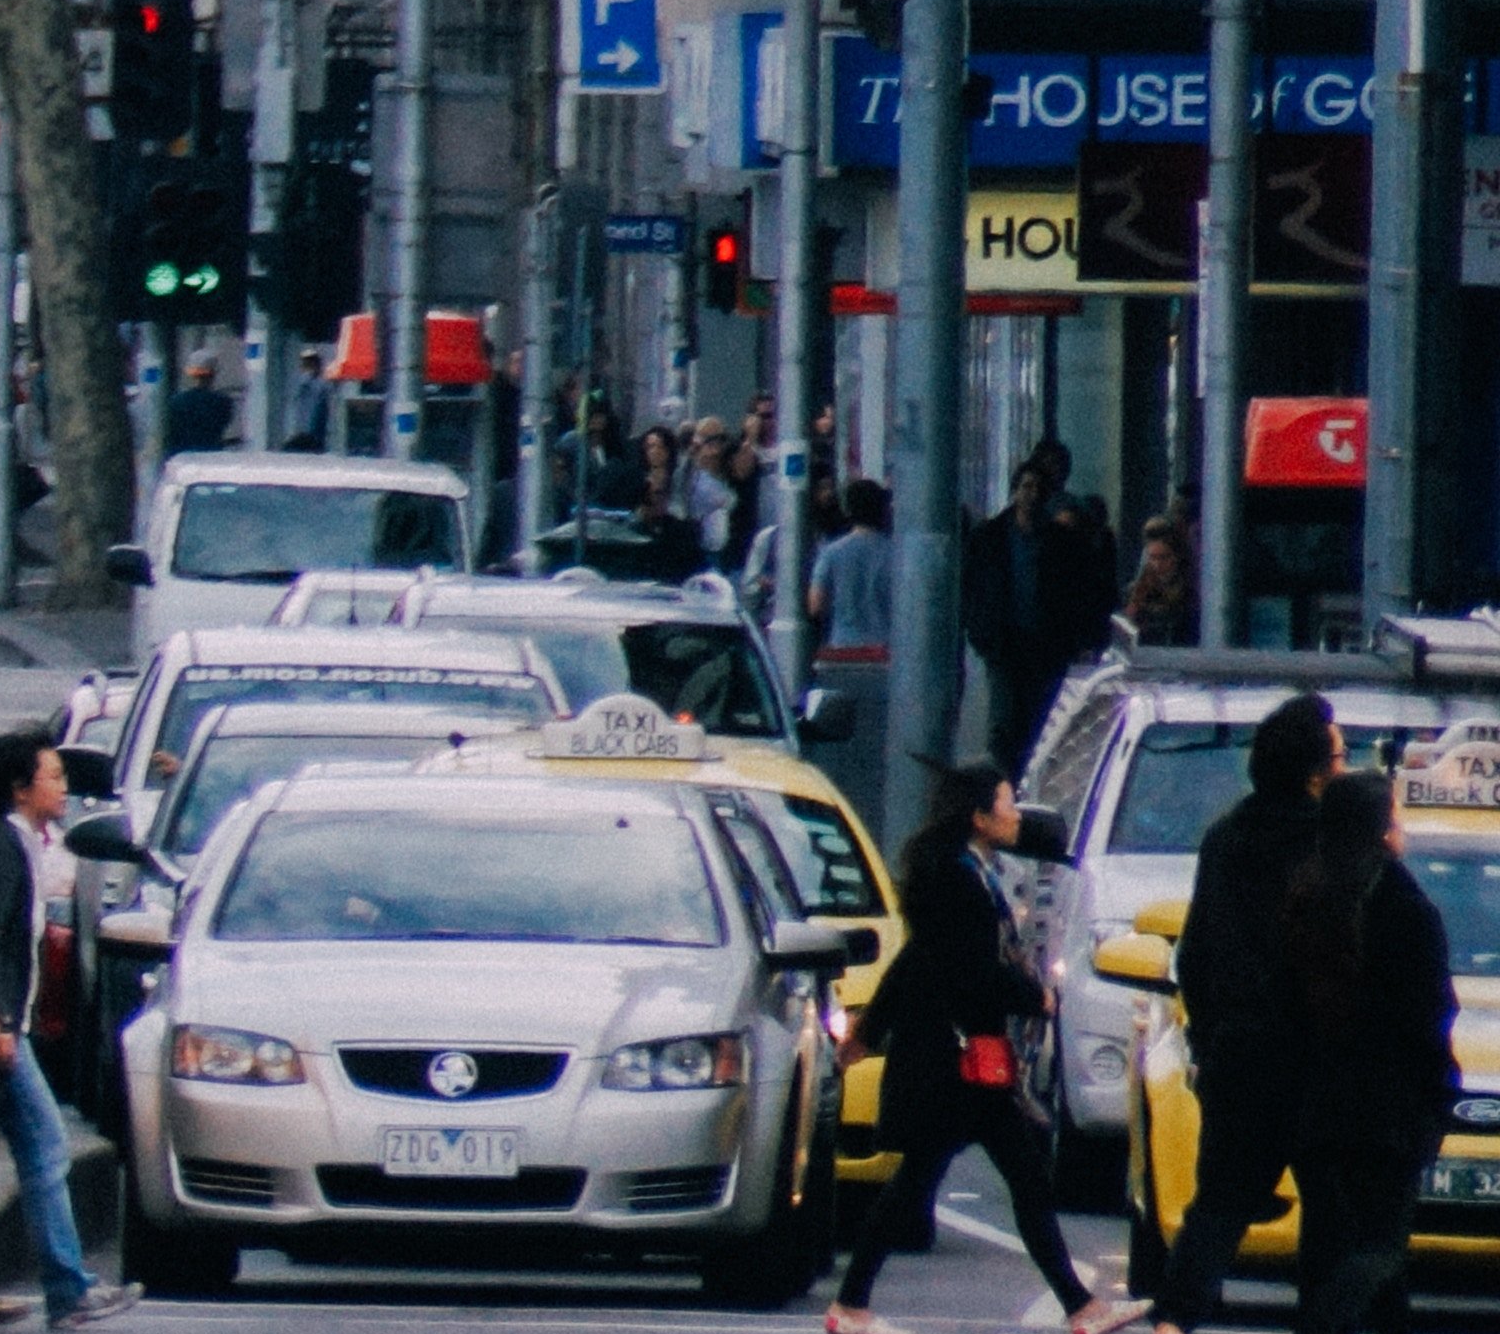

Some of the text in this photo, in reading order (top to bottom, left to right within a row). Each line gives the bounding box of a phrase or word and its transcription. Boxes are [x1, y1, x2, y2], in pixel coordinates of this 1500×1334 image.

[601, 711, 657, 733] TAXI
[570, 733, 679, 756] BLACK CABS
[1406, 780, 1483, 803] Black
[389, 1134, 514, 1164] ZDG 019
